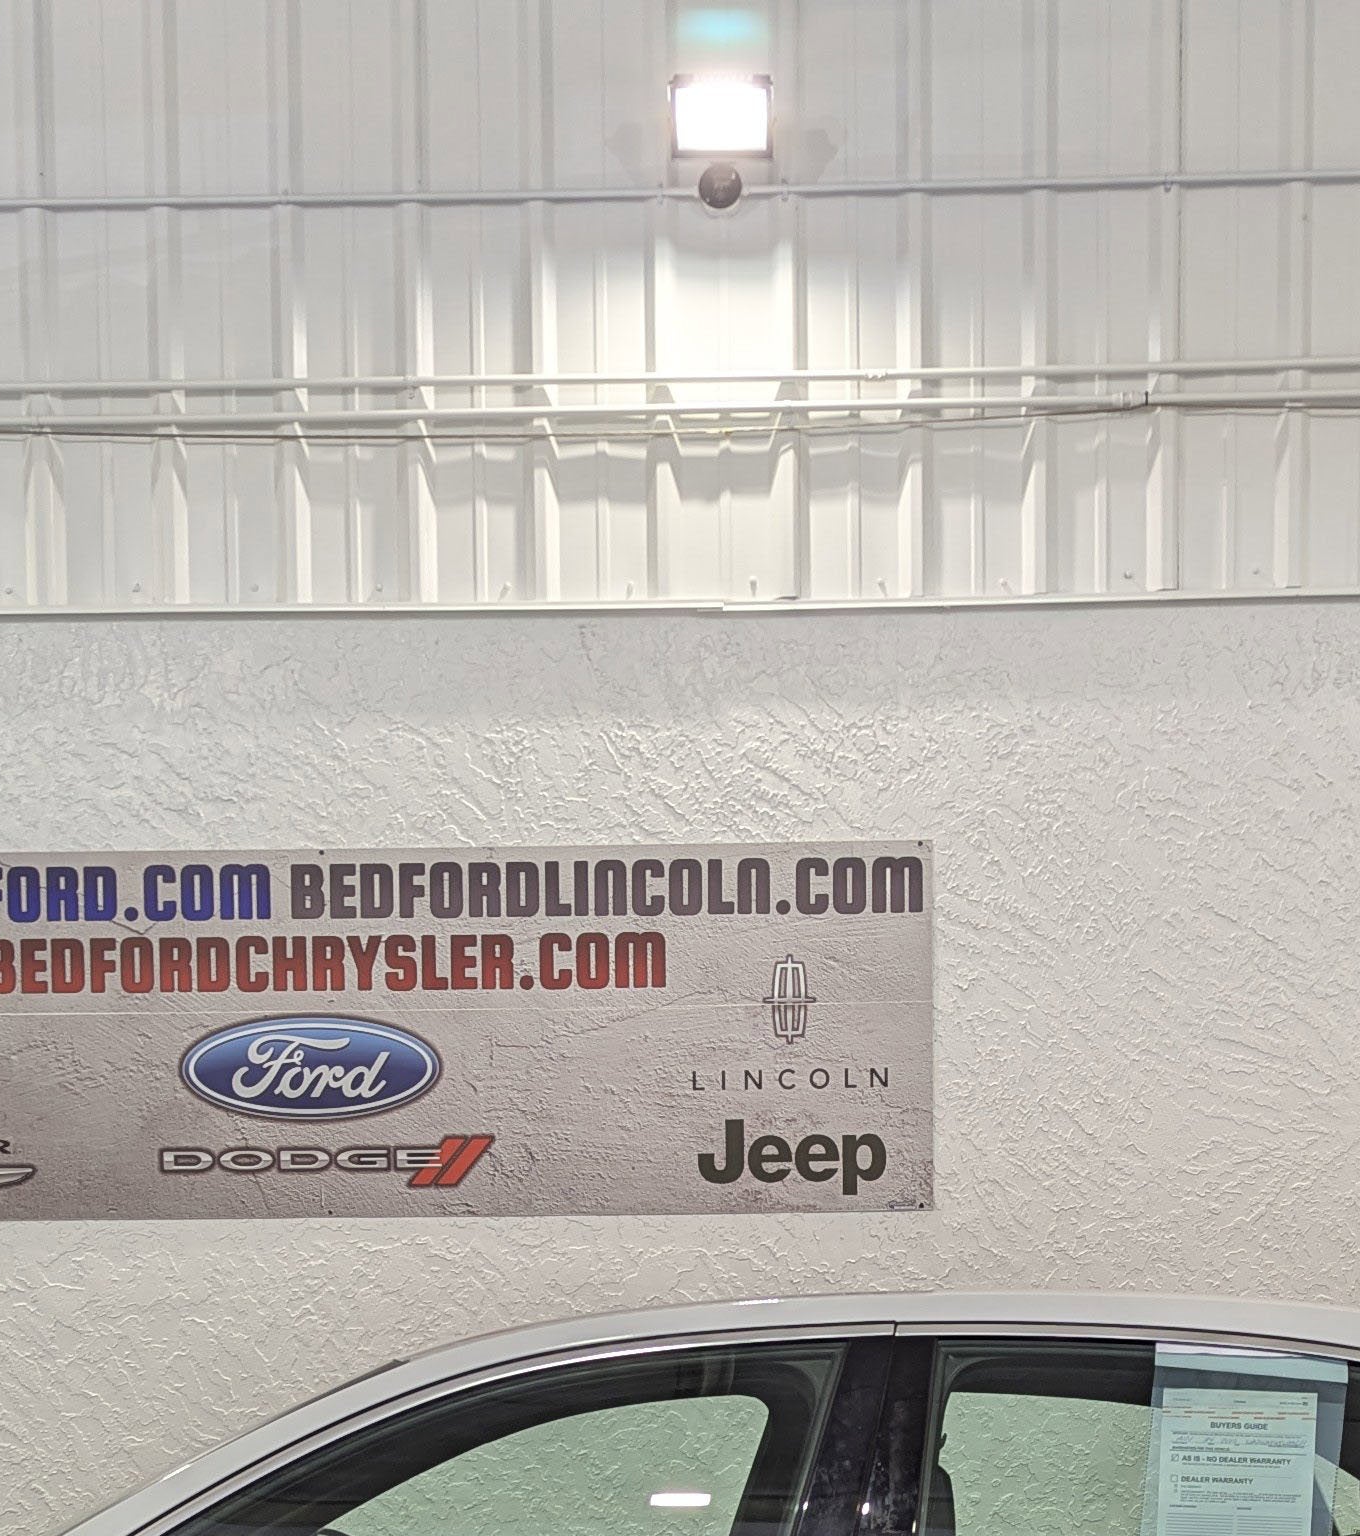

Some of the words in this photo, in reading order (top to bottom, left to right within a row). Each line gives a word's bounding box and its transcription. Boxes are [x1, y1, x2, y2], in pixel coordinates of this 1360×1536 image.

[290, 856, 925, 920] BEDFORDLINCOLN.COM
[231, 1033, 391, 1099] Ford
[691, 1067, 889, 1091] LINCOLN
[161, 1149, 444, 1172] DODGE
[697, 1118, 887, 1196] Jeep
[1210, 1421, 1242, 1430] BUYERS
[1243, 1422, 1269, 1431] GUIDE
[1218, 1456, 1248, 1464] DEALER
[1249, 1457, 1292, 1466] WARRANTY
[1180, 1476, 1210, 1484] DEALER
[1211, 1477, 1254, 1485] WARRANTY
